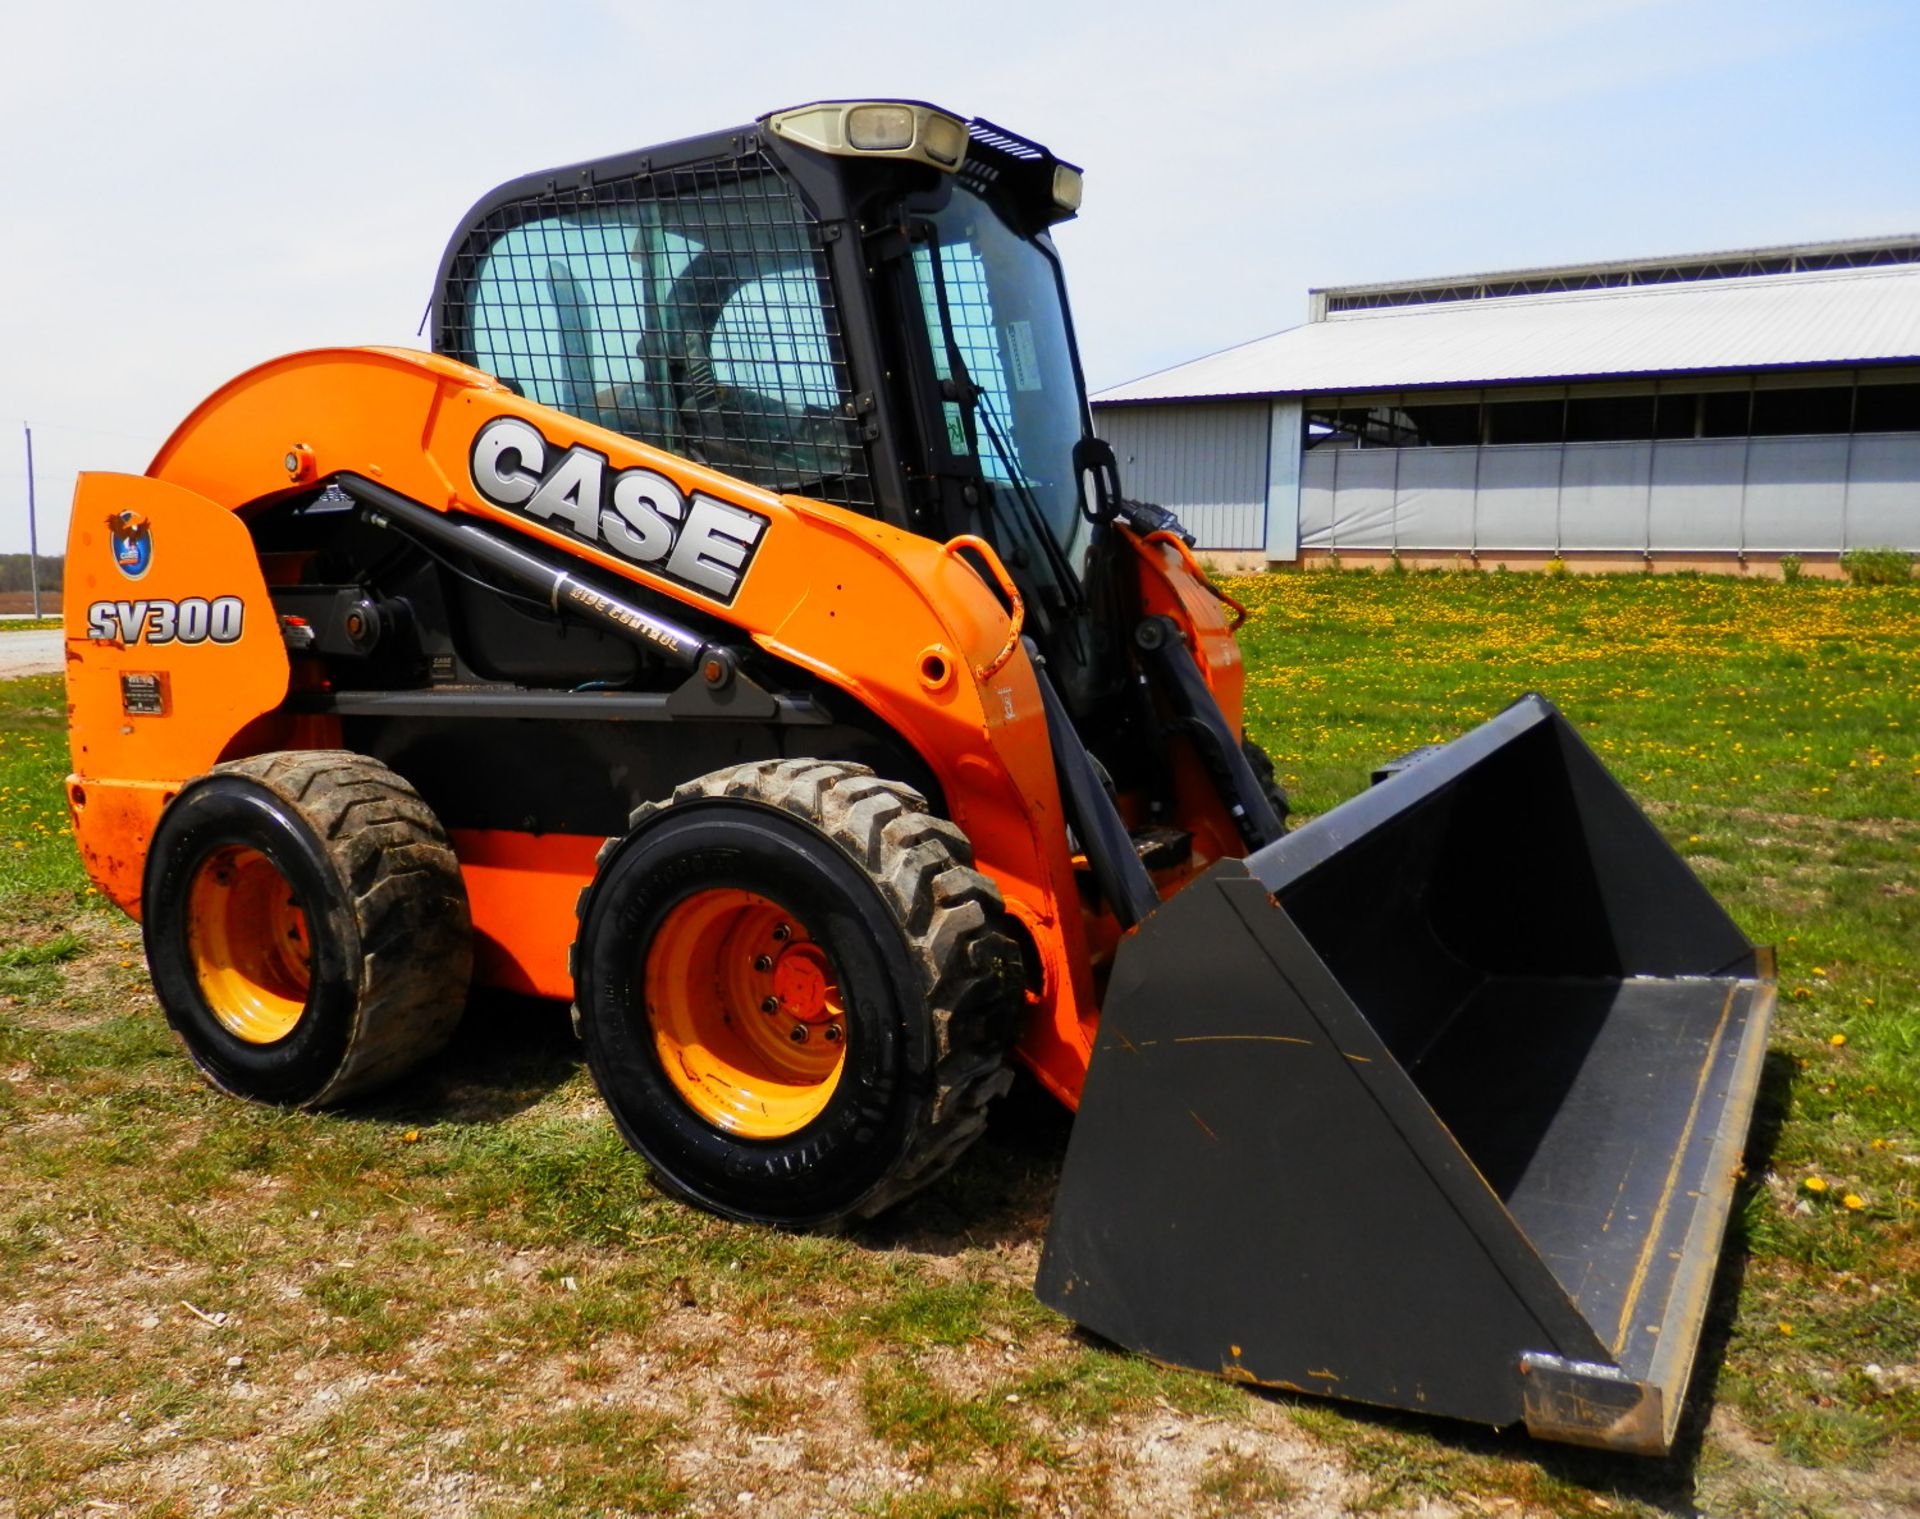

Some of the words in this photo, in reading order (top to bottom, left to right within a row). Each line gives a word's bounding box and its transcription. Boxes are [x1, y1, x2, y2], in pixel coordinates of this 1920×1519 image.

[473, 416, 766, 598] CASE
[87, 595, 243, 644] SV300
[608, 606, 679, 652] CONTROL
